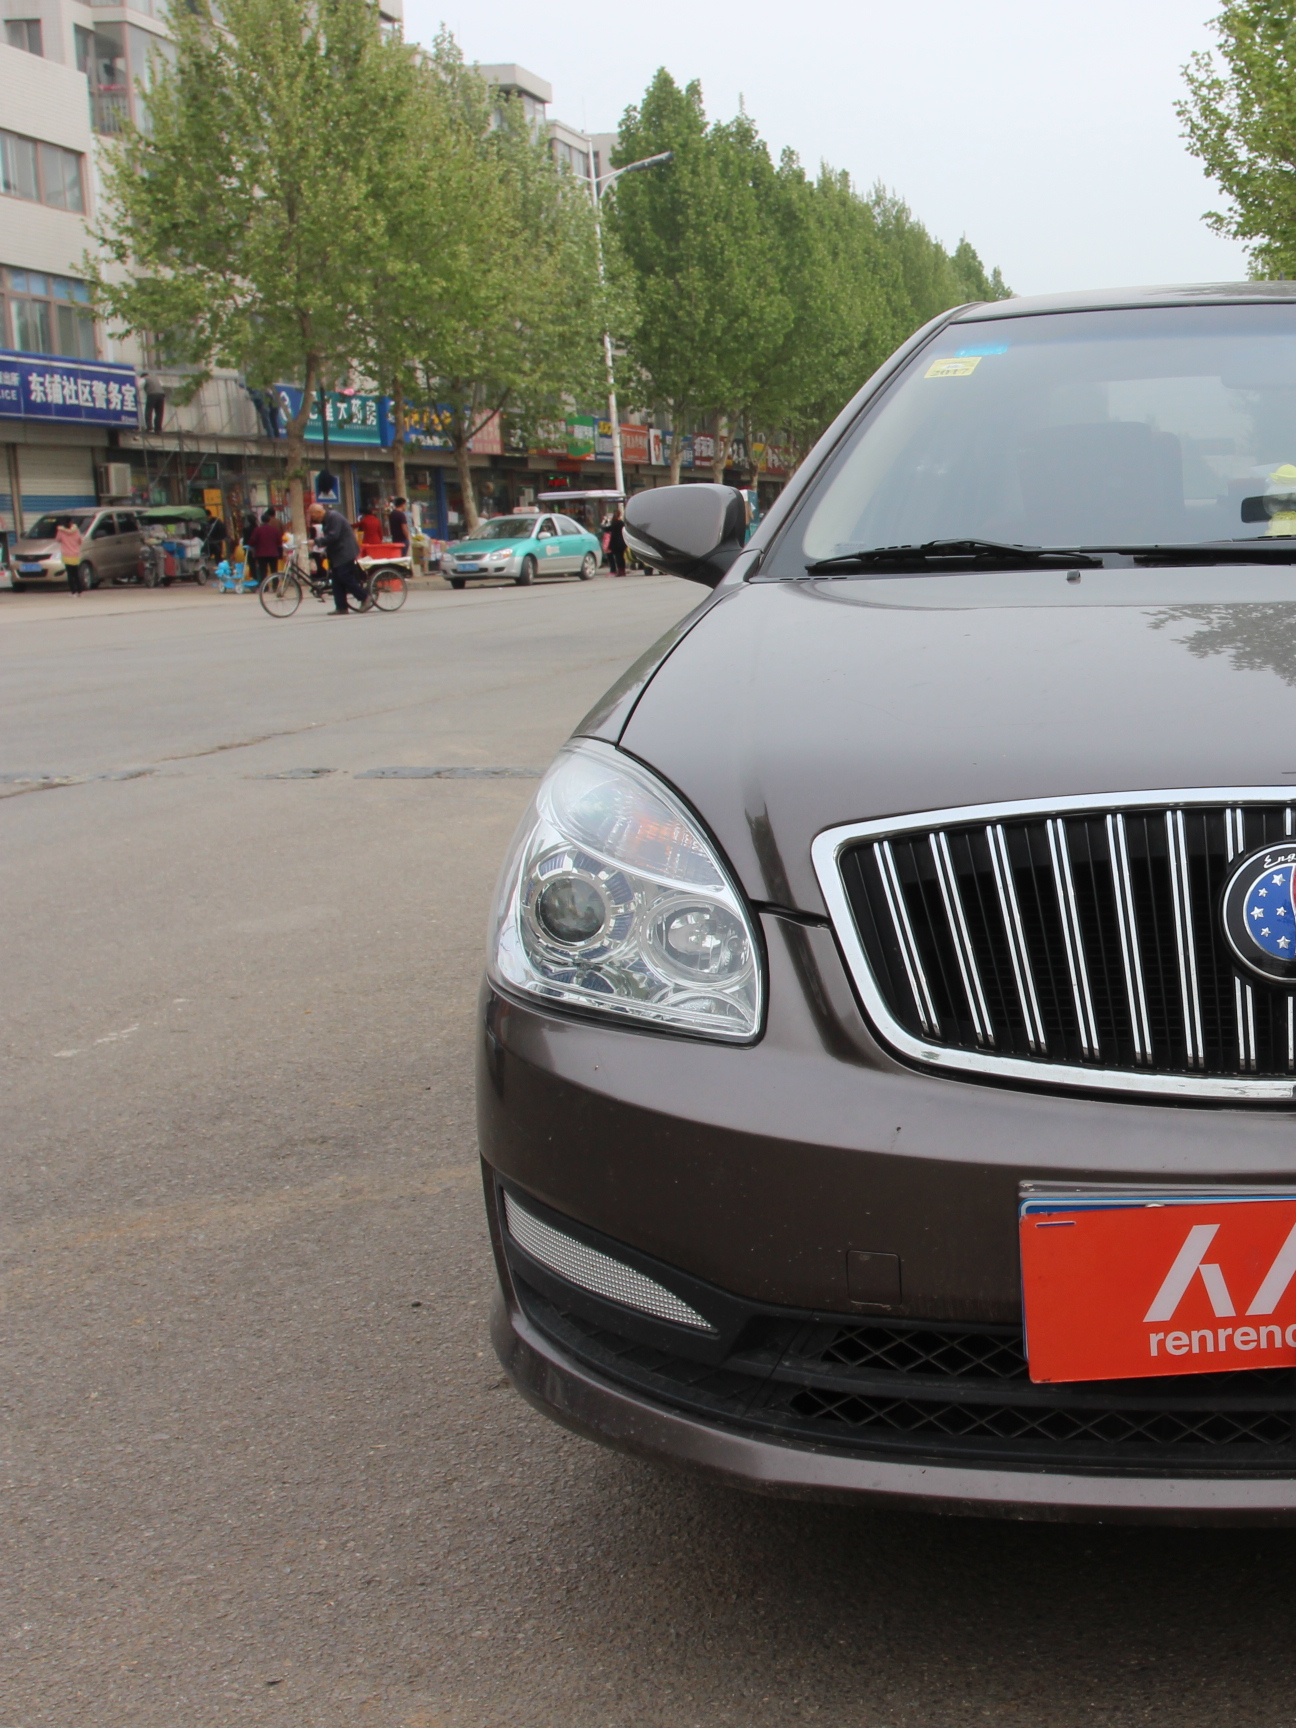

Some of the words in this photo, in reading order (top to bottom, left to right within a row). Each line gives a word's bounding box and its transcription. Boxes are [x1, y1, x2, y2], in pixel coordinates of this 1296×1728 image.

[930, 369, 970, 377] 2017
[28, 372, 138, 412] 东铺社区警务室
